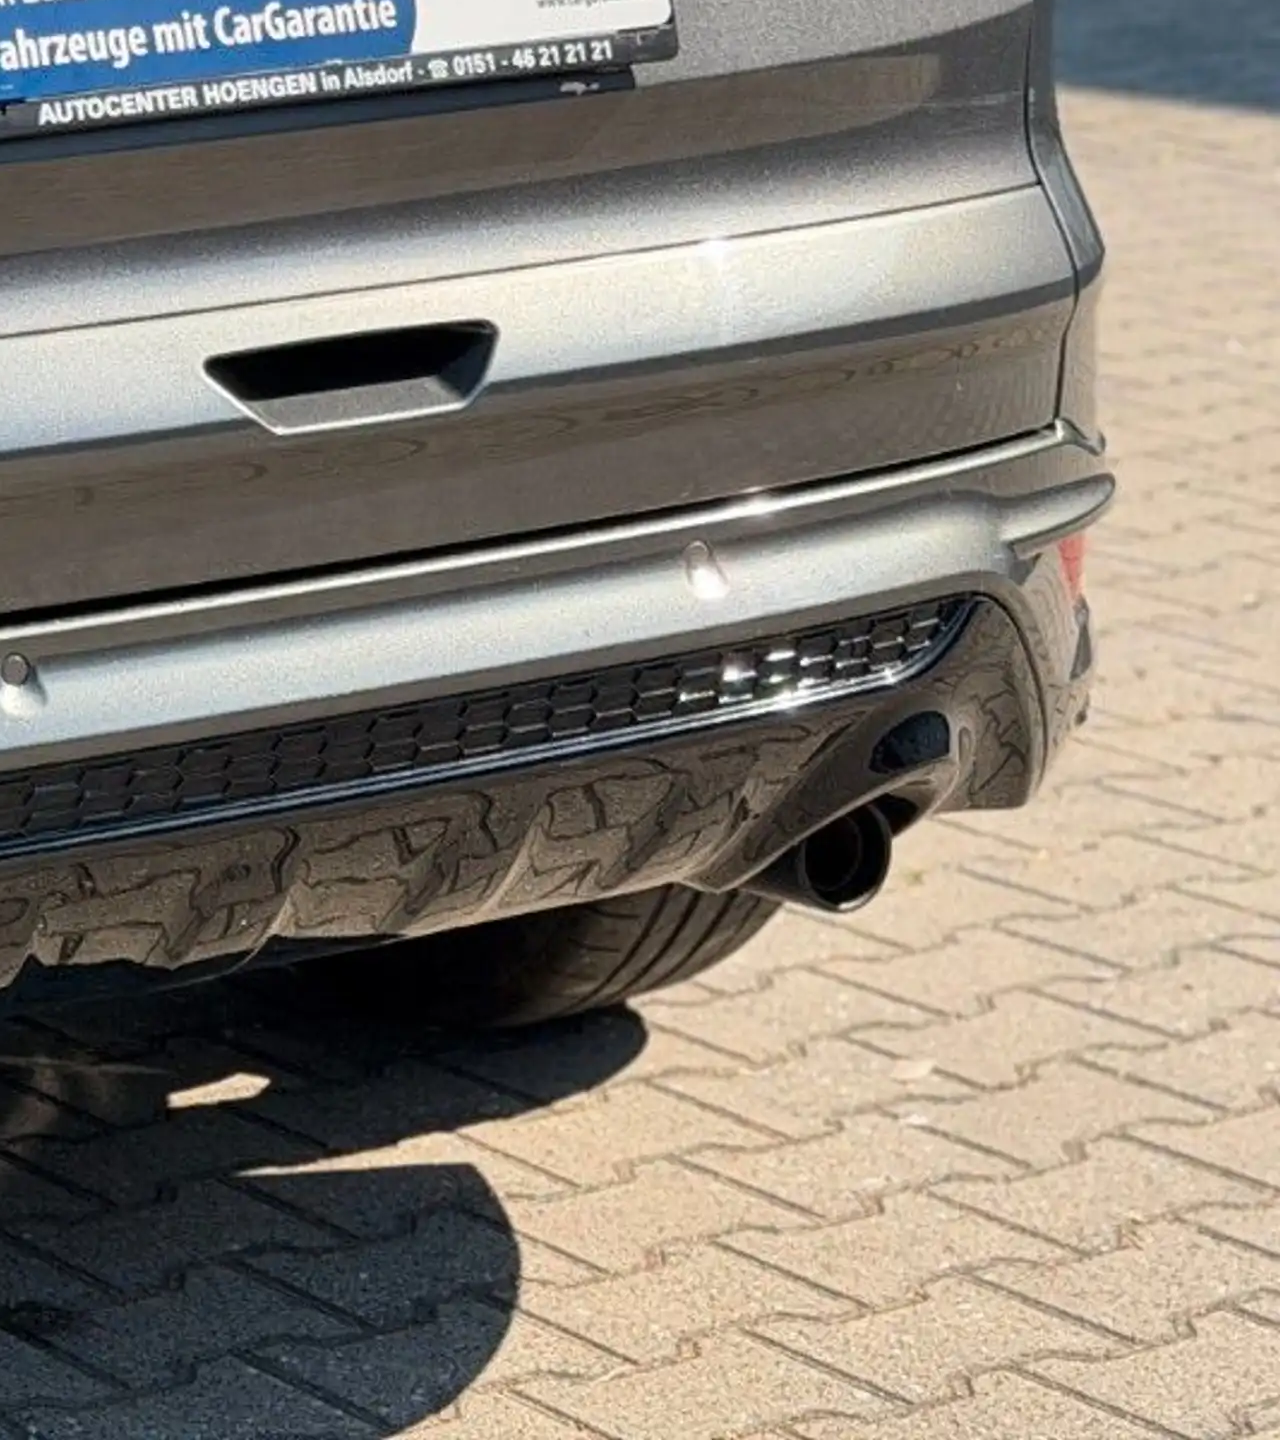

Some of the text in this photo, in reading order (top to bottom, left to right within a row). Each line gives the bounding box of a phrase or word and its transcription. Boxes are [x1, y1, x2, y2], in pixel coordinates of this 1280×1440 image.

[152, 9, 211, 54] mit
[38, 85, 199, 126] AUTOCENTER
[203, 71, 317, 106] HOENGEN
[321, 70, 341, 91] in
[343, 60, 413, 89] Alsdorf
[453, 51, 496, 75] 0151
[538, 45, 561, 67] 21
[563, 41, 587, 63] 21
[590, 38, 614, 61] 21
